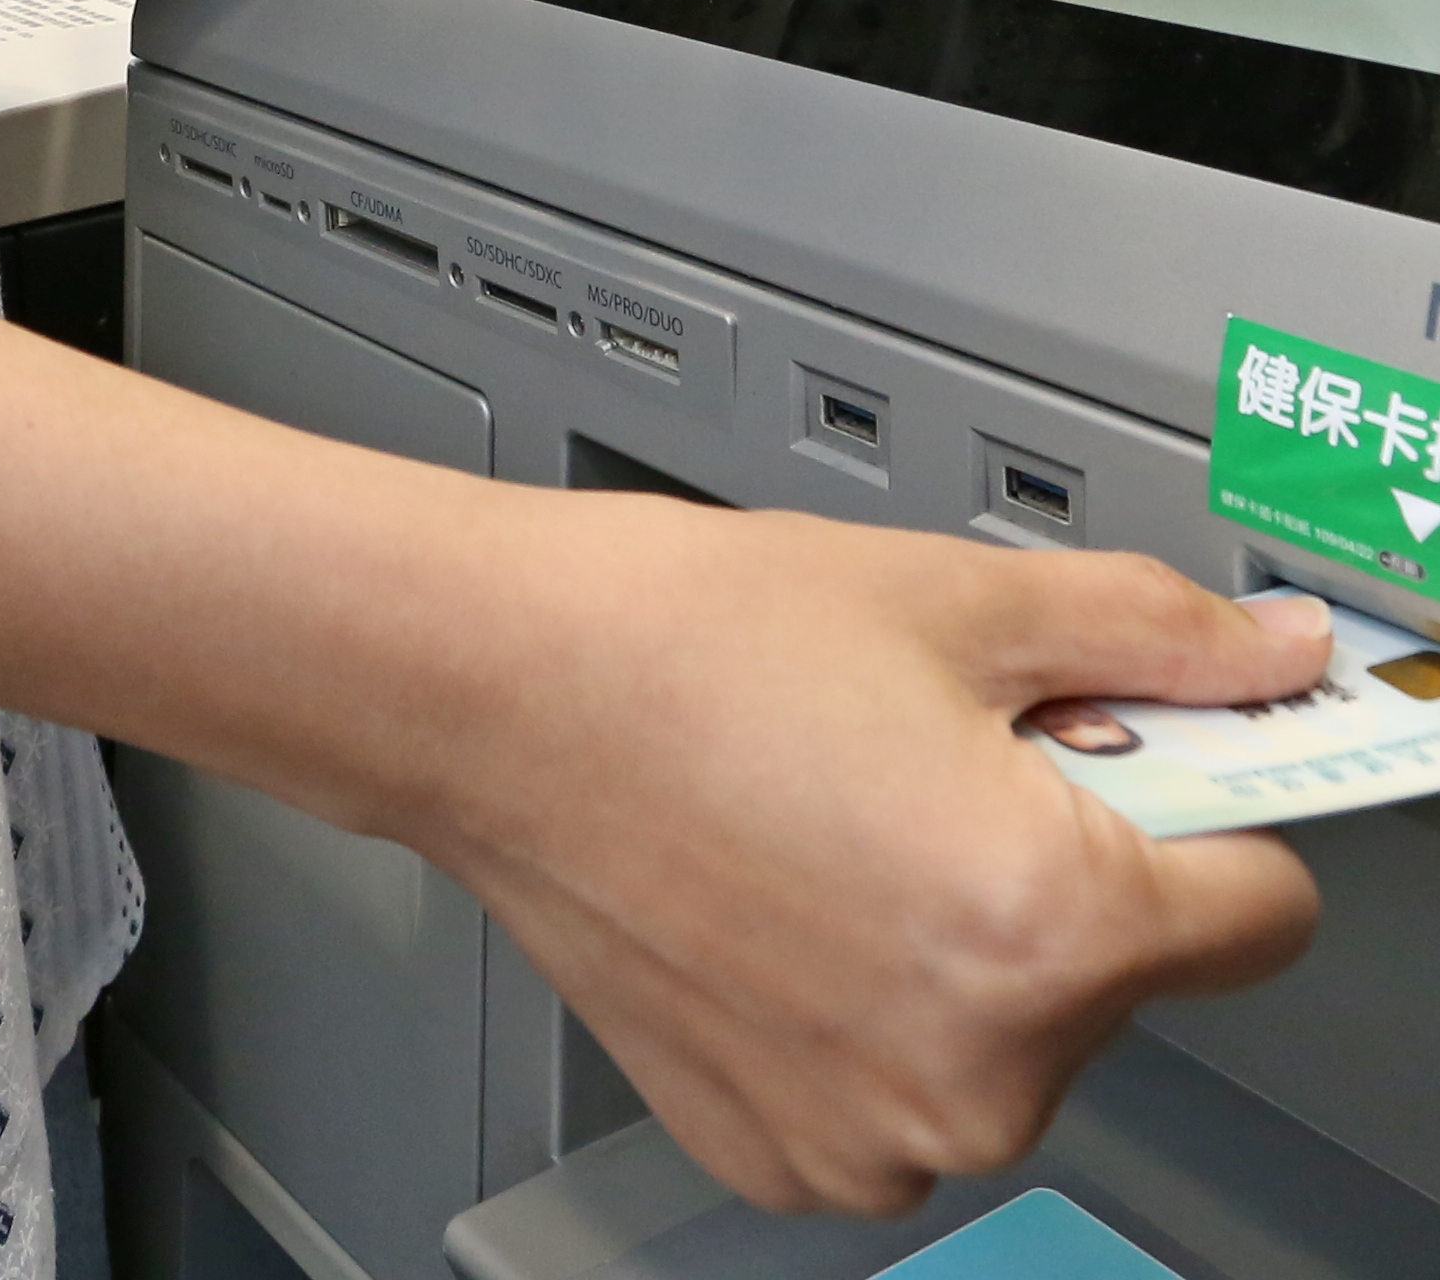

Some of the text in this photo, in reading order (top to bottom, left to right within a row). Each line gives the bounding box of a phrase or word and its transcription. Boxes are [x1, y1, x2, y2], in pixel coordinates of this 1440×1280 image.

[170, 118, 237, 158] SD/SDHC/SDXC
[254, 154, 294, 180] microSD
[349, 189, 404, 226] CF/UDMA
[466, 235, 564, 290] SD/SDHC/SDXC
[587, 283, 685, 337] MS/PRO/DUO
